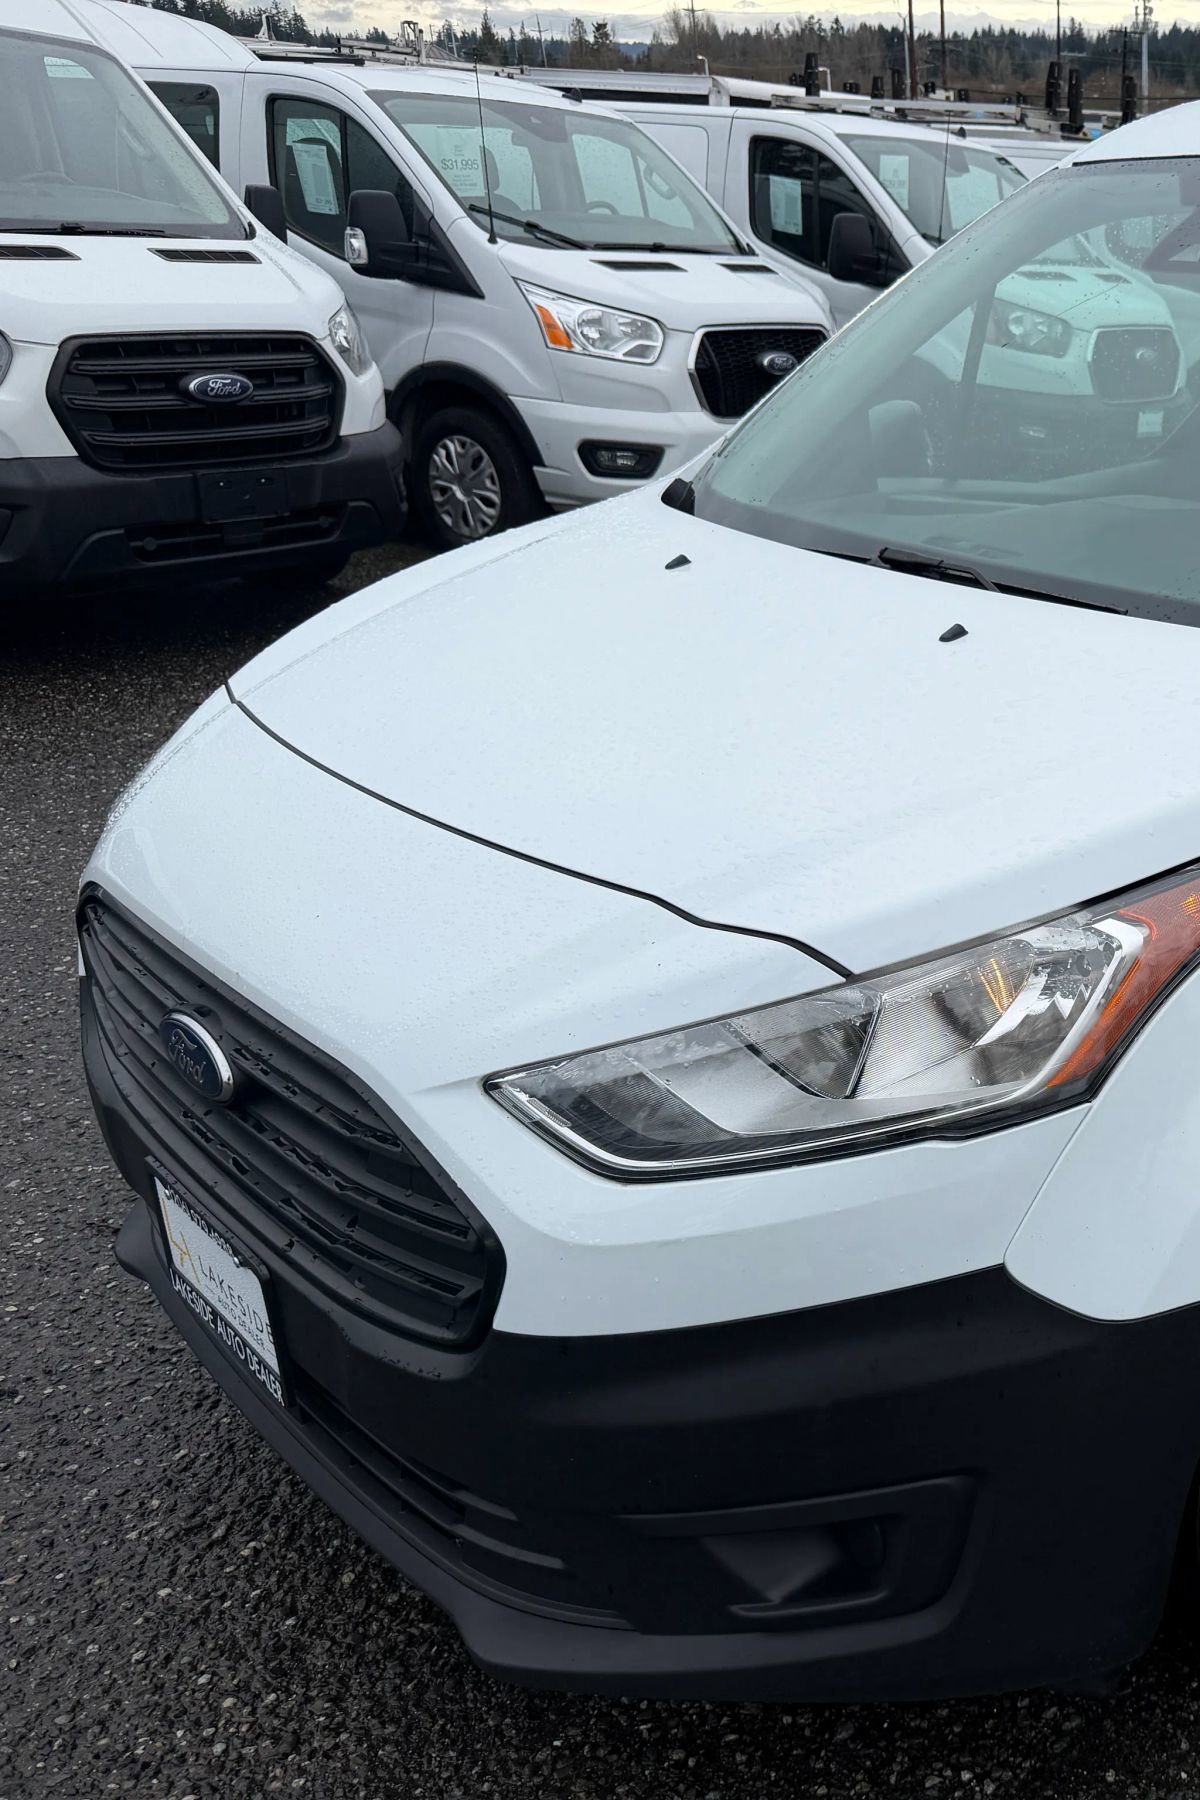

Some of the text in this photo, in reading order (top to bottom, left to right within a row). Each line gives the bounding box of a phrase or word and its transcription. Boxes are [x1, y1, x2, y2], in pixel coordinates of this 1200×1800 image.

[441, 158, 480, 171] $31,995
[207, 379, 242, 396] Ford
[168, 1028, 207, 1084] Ford
[198, 1255, 275, 1344] LAKESIDE
[169, 1267, 216, 1329] LAKESIDE
[217, 1315, 246, 1360] AUTO
[246, 1346, 285, 1407] DEALER
